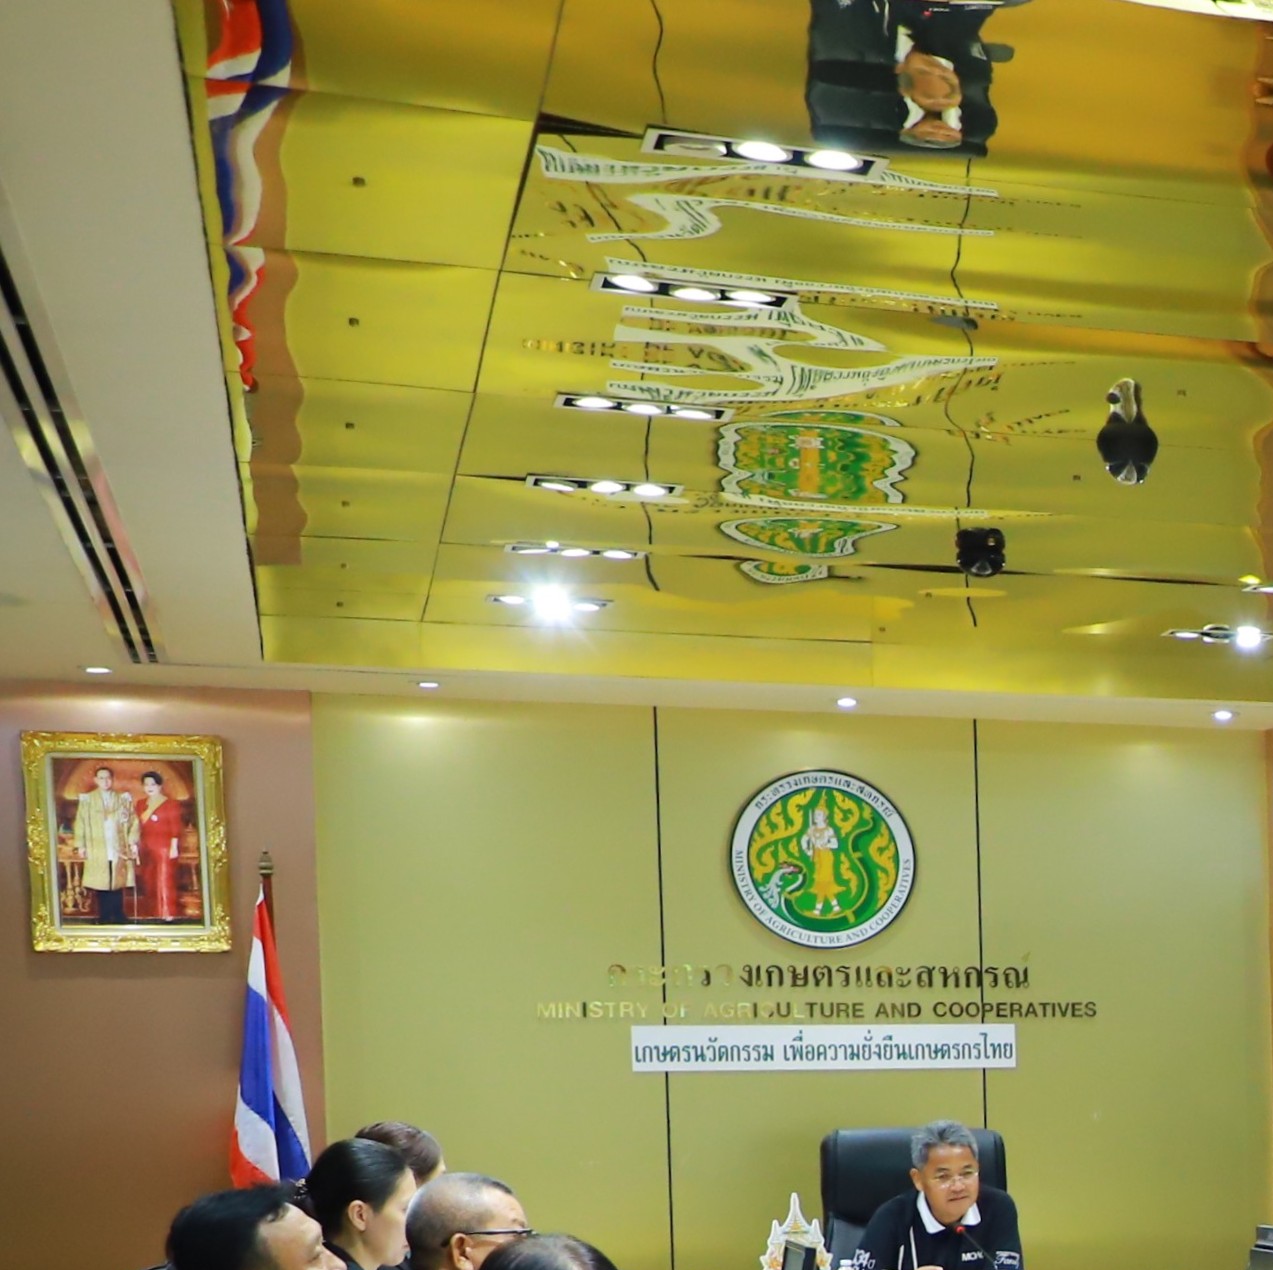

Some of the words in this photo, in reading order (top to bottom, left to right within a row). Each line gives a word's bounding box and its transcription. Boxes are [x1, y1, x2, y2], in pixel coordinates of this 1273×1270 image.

[735, 850, 757, 904] MINISTRY
[753, 902, 765, 917] OF
[766, 914, 845, 945] AGRICULTURE
[844, 927, 869, 943] AND
[868, 858, 911, 931] COOPERATIVES
[536, 1001, 649, 1019] MINISTRY
[662, 1001, 688, 1018] OF
[875, 1001, 922, 1018] AND
[933, 1001, 1097, 1019] COOPERATIVES
